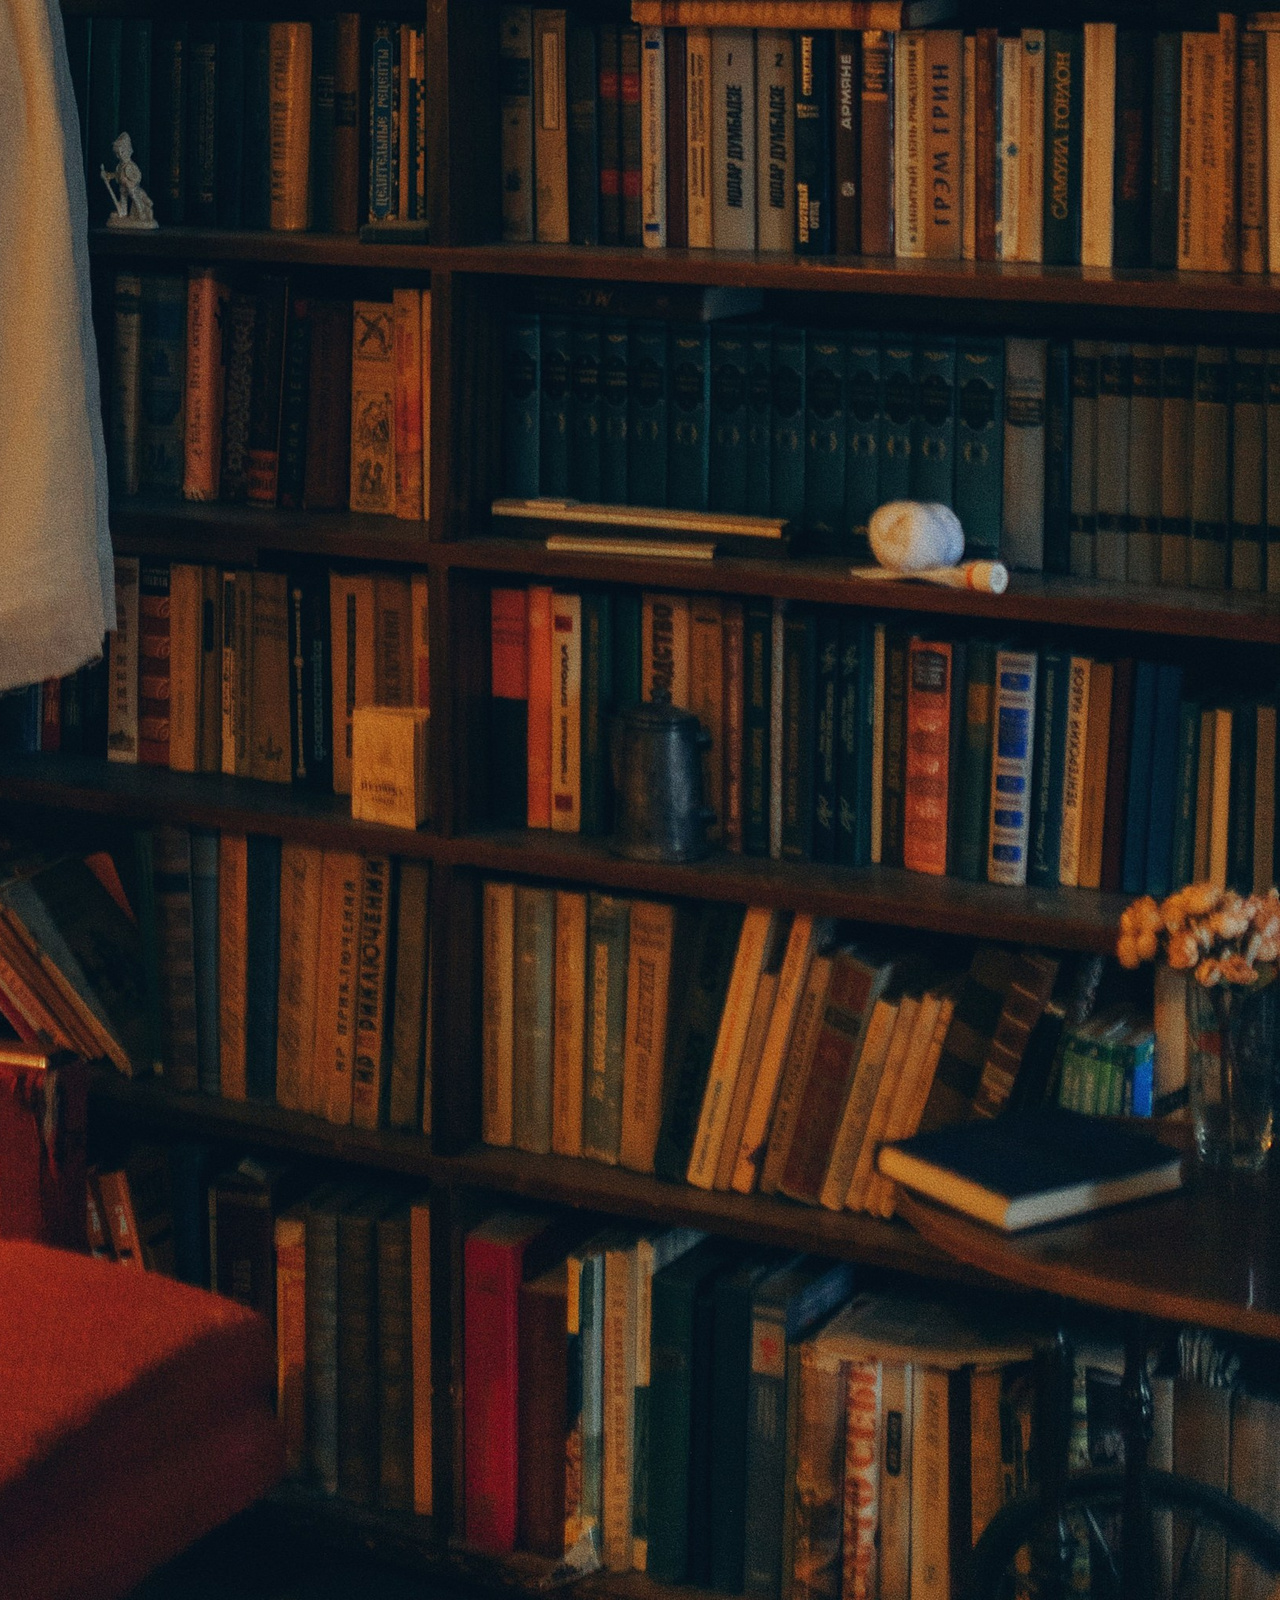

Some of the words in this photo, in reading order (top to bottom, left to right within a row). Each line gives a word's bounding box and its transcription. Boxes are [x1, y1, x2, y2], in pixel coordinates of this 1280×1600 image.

[374, 47, 390, 109] РЕЦЕПТЫ
[775, 52, 784, 68] 2
[840, 54, 852, 130] АРМЯНЕ
[1053, 50, 1071, 131] ГОРДОН
[726, 83, 745, 161] ДУМБАДЗЕ
[769, 83, 787, 161] ДУМБАДЗЕ
[931, 63, 950, 135] ГРИН
[374, 115, 390, 207] ЦЕЛИТЕЛЬНЫЕ
[726, 163, 743, 209] НОДАР
[769, 163, 786, 209] НОДАР
[933, 151, 951, 226] ГРЭМ
[1052, 134, 1070, 220] САМУИЛ
[1070, 666, 1085, 715] НАБОБ
[1066, 719, 1081, 809] ВЕНГЕРСКИЙ
